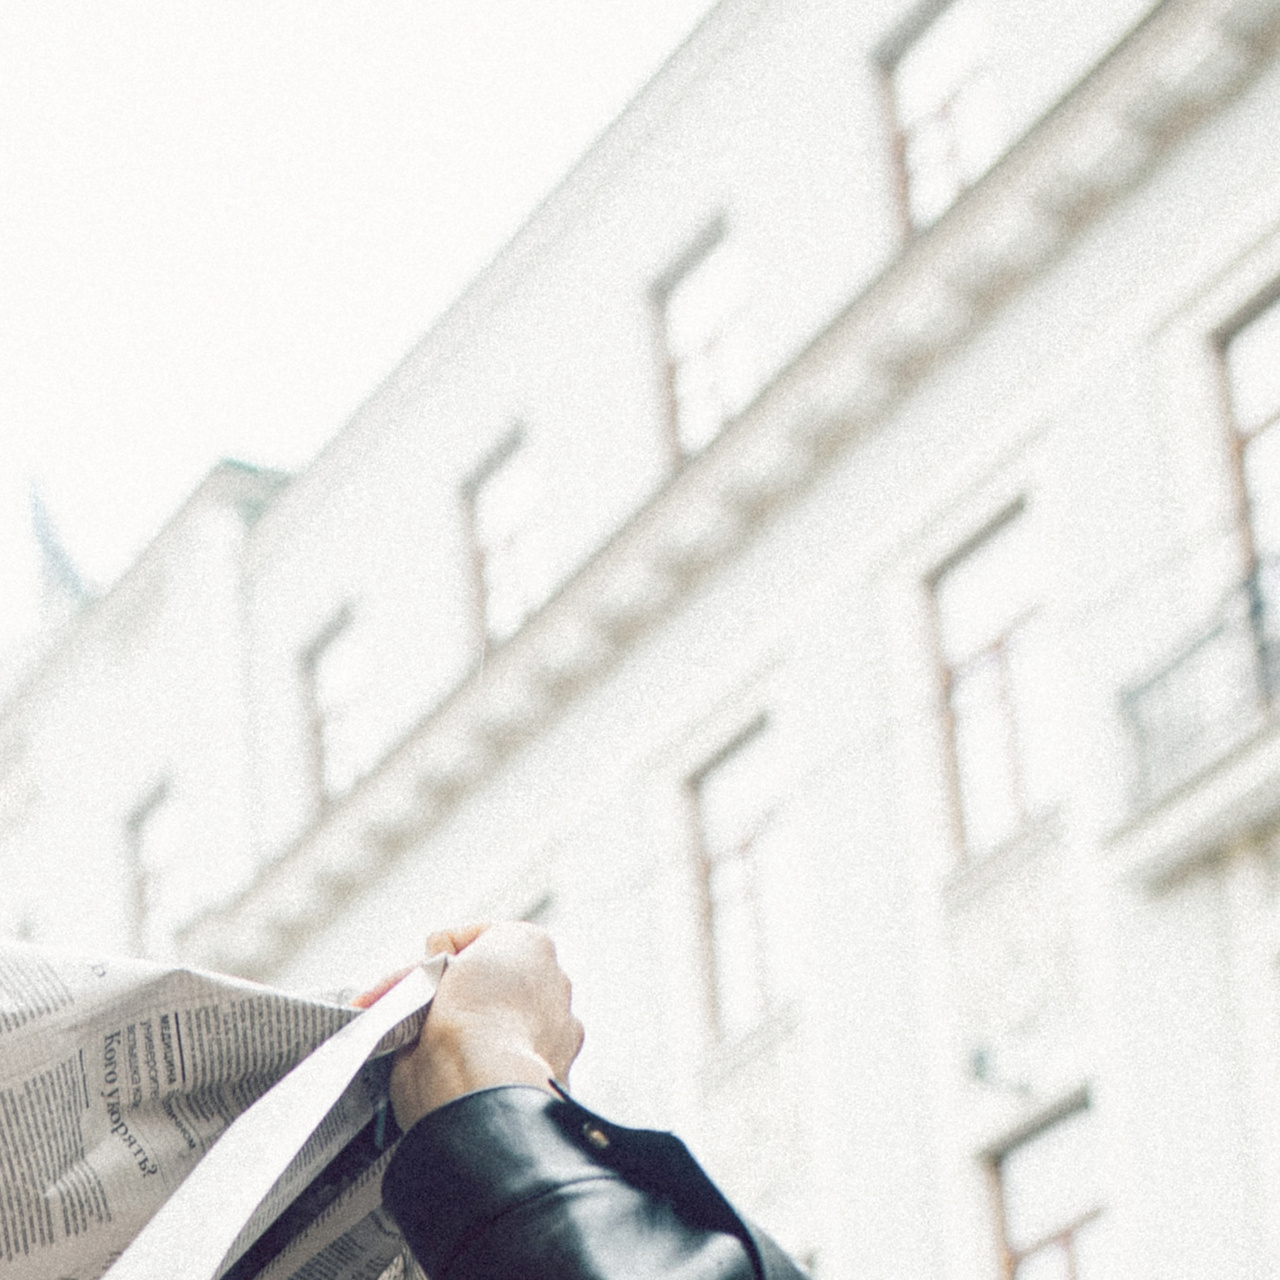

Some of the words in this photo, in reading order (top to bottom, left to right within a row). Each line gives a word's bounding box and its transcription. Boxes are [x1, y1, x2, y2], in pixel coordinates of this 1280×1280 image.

[104, 1029, 122, 1084] Кого
[140, 1017, 160, 1100] университе
[160, 1014, 177, 1085] МЕДИЦИНА
[101, 1086, 158, 1178] укорять?
